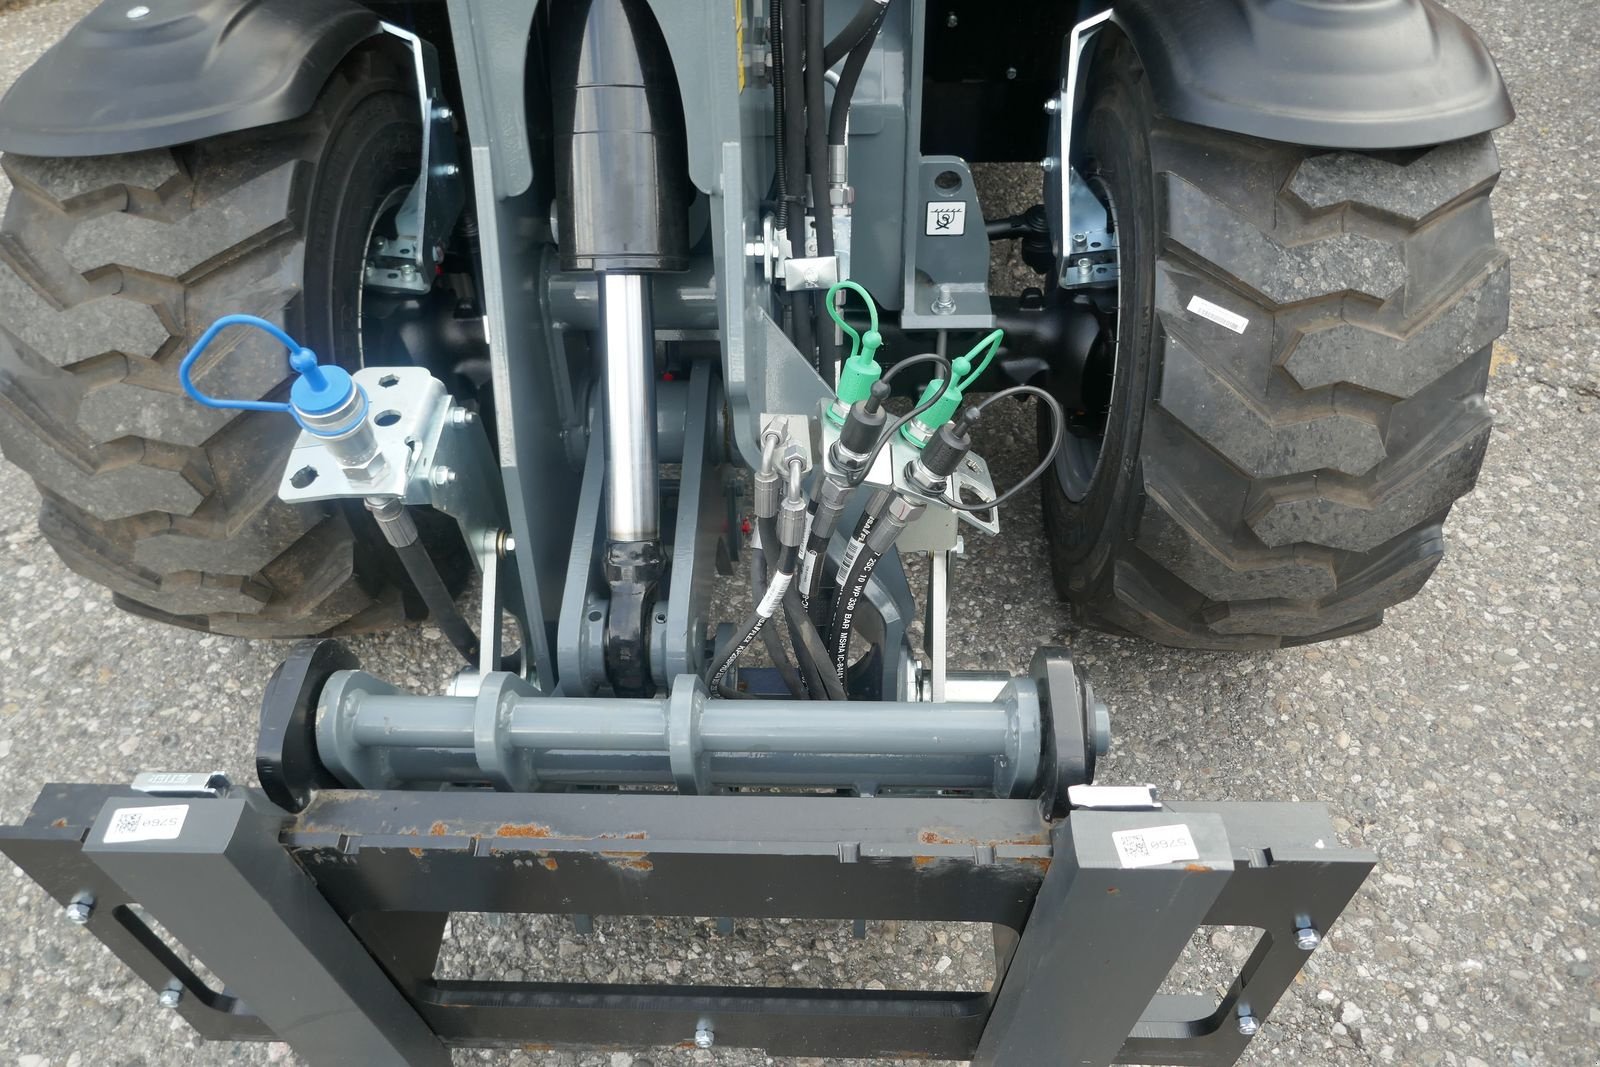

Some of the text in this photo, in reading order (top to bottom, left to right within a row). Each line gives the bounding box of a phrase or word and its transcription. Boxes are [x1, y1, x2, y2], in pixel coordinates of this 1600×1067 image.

[858, 574, 867, 583] 10
[852, 585, 862, 597] WP
[847, 597, 857, 611] 330
[842, 613, 852, 629] BAR
[837, 632, 848, 653] MSHA
